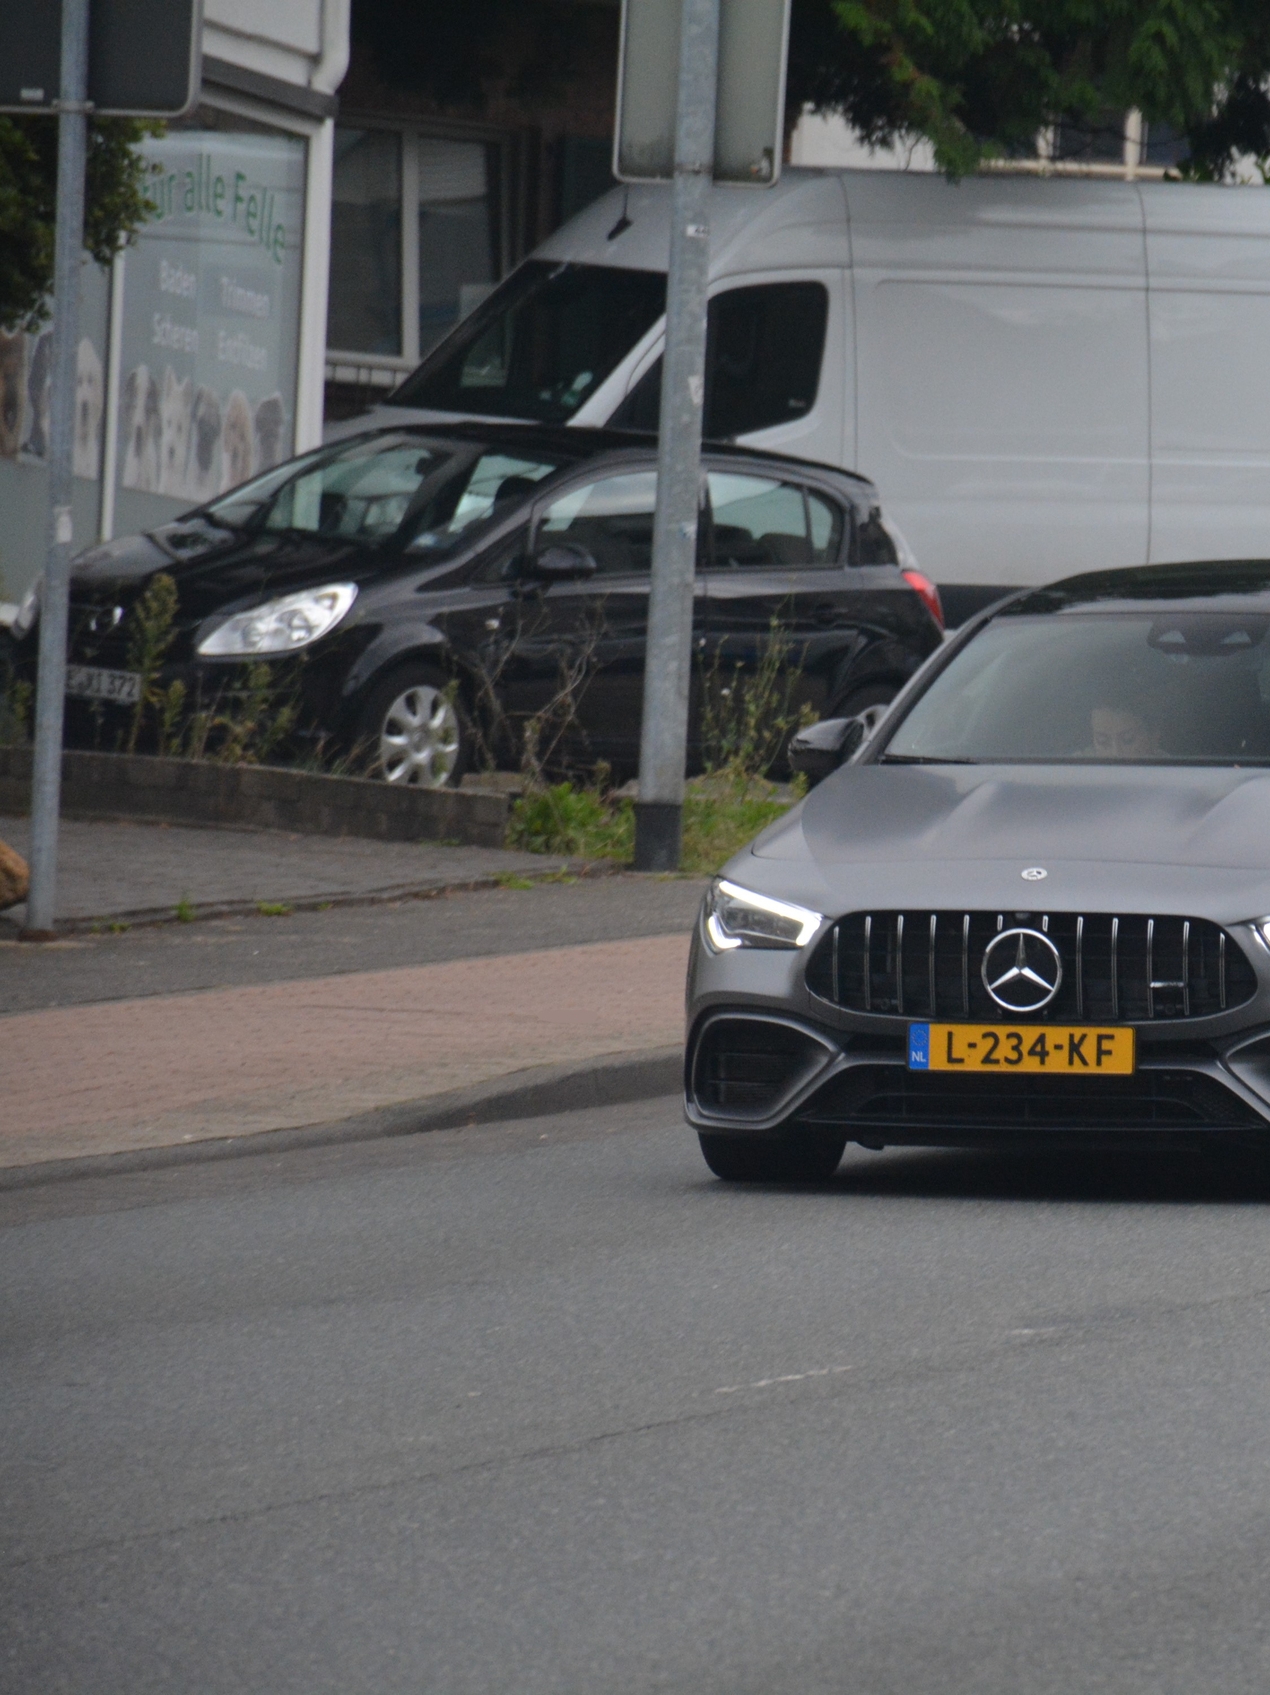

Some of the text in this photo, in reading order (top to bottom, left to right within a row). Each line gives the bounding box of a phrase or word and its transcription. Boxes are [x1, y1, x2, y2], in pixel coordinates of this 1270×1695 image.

[184, 152, 226, 217] alle
[233, 171, 286, 264] Felle
[911, 1051, 926, 1063] NL
[946, 1031, 1116, 1067] L-234-KF
